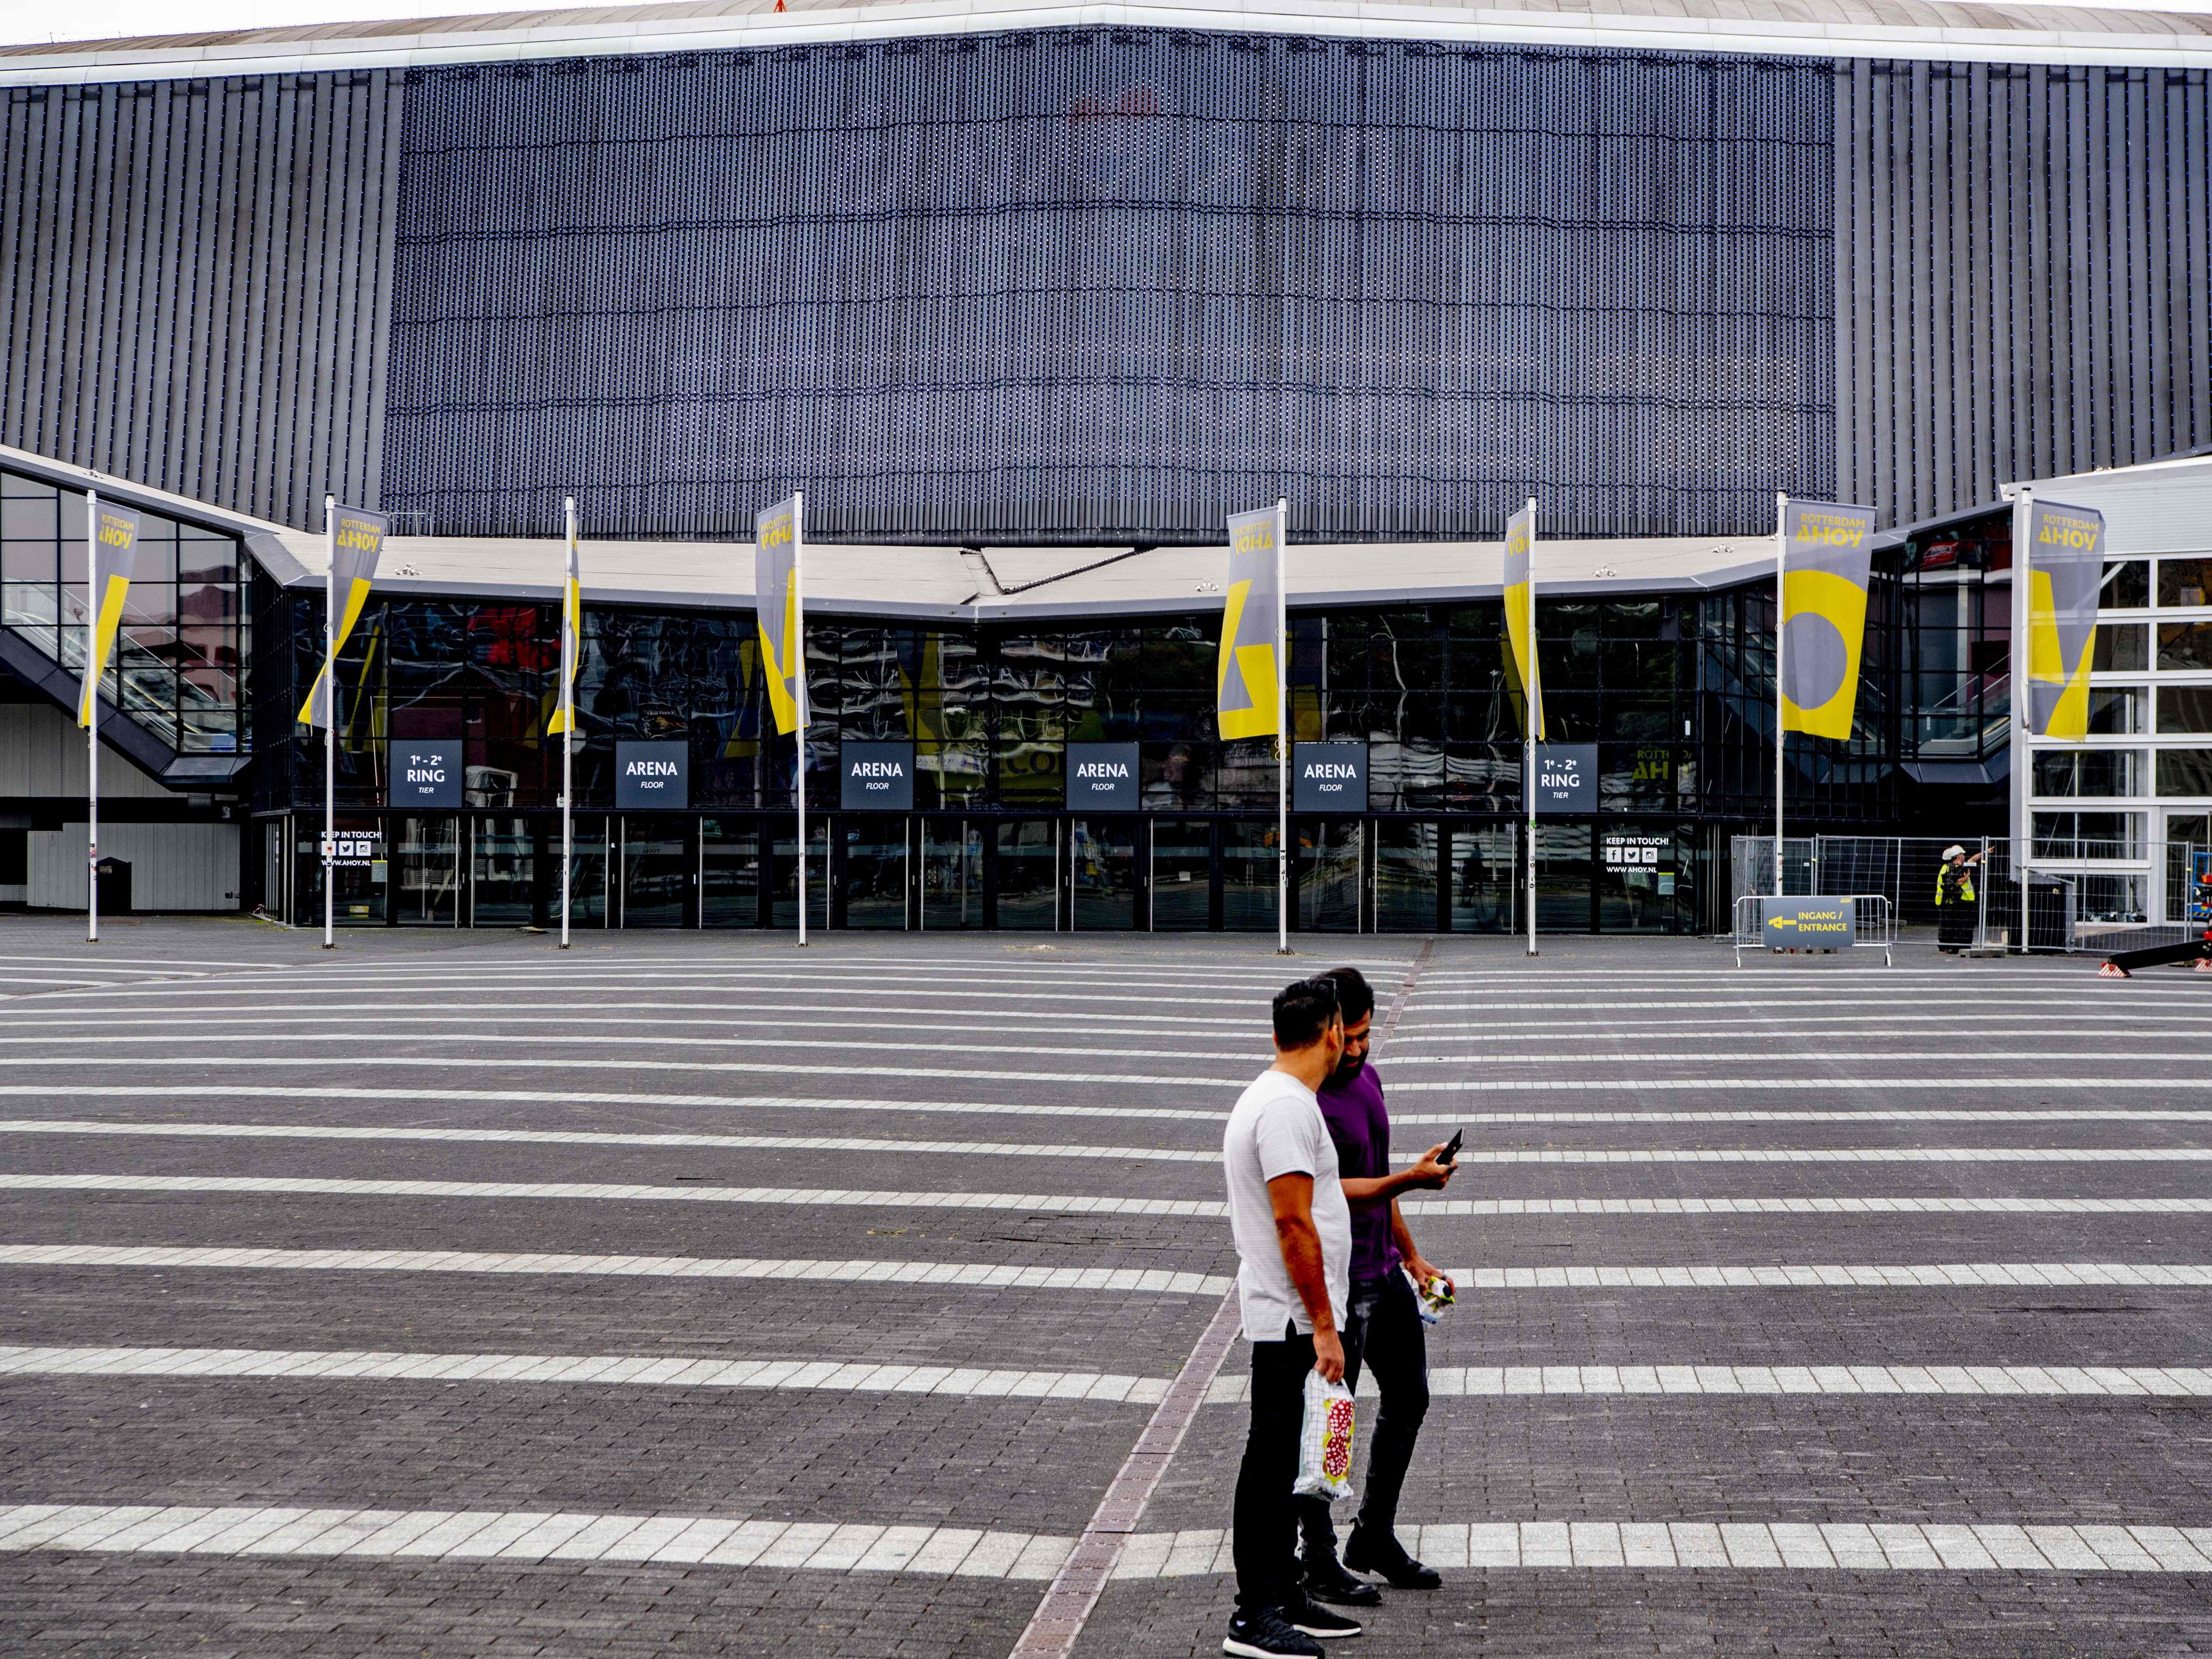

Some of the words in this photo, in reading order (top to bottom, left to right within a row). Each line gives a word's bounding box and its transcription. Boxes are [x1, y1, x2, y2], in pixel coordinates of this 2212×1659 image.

[341, 518, 381, 535] ROTTERDAM
[1801, 514, 1865, 528] ROTTERDAM
[2043, 514, 2099, 532] ROTTERDAM
[336, 529, 379, 552] AHOY
[1795, 525, 1863, 548] AHOY
[2039, 525, 2097, 551] AHOY
[626, 761, 678, 775] ARENA
[851, 762, 903, 776] ARENA
[1077, 763, 1129, 777] ARENA
[1304, 764, 1357, 778] ARENA
[407, 769, 445, 782] RING
[1541, 774, 1580, 787] RING
[1798, 911, 1837, 920] INGANG
[1798, 923, 1847, 932] ENTRANCE
